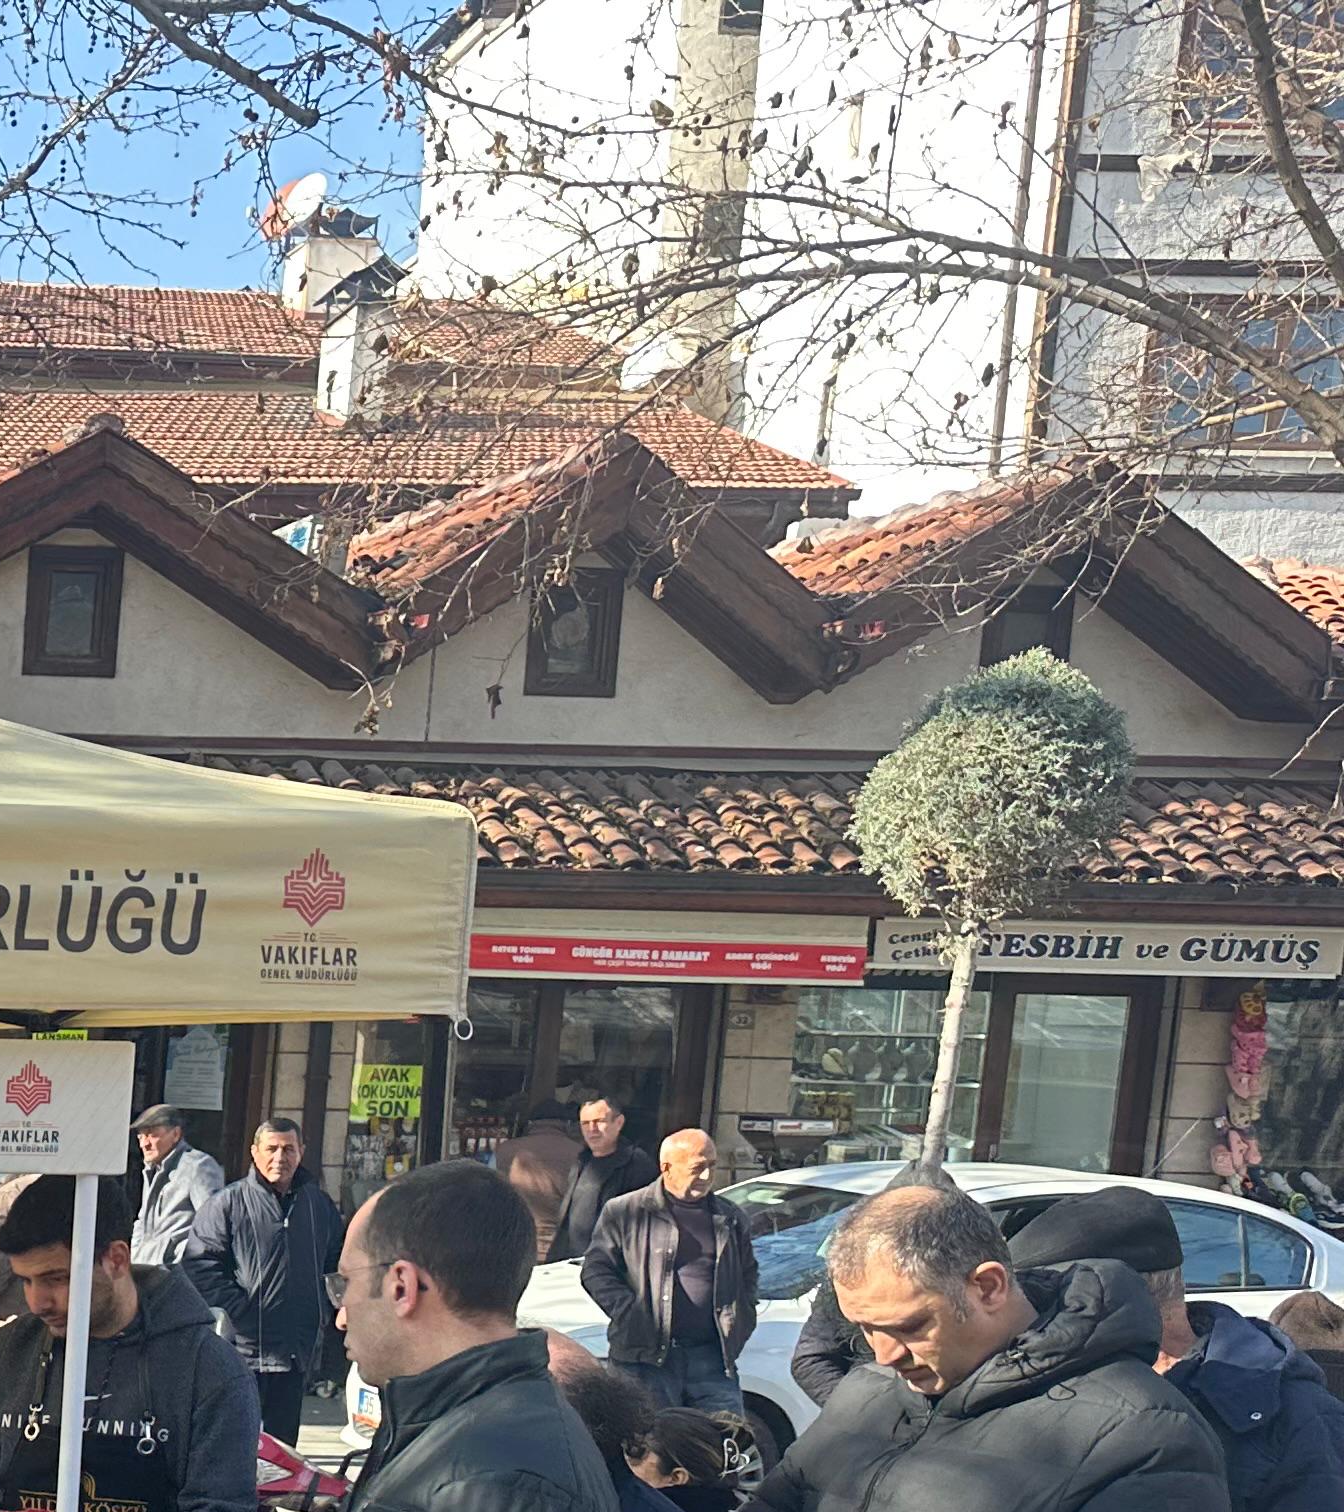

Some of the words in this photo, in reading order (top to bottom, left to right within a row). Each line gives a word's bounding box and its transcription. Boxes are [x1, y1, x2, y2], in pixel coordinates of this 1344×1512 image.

[888, 927, 946, 946] Cengi
[261, 944, 358, 967] VAKIFLAR
[891, 943, 950, 962] Çetki
[978, 929, 1124, 960] TESBİH
[1136, 943, 1169, 959] ve
[1179, 932, 1321, 971] GÜMÜŞ
[260, 968, 291, 980] GENEL
[295, 967, 358, 981] MÜDÜRLÜĞÜ
[369, 1067, 411, 1083] AYAK
[365, 1100, 410, 1118] SON
